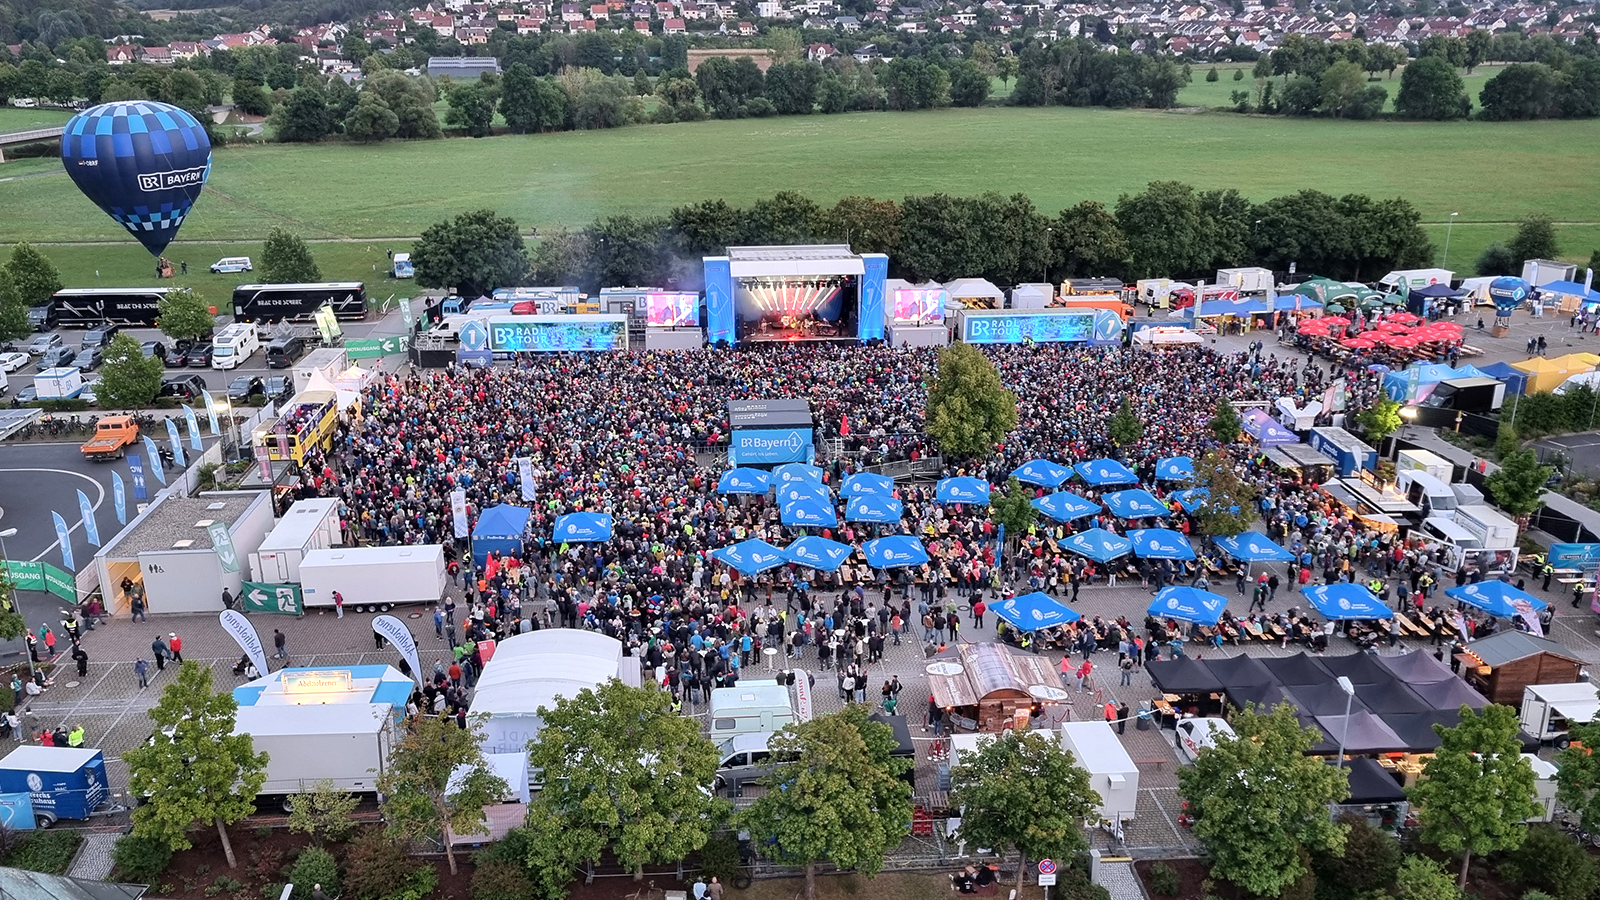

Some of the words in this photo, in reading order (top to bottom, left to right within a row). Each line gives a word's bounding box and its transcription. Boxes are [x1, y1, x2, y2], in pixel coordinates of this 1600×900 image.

[142, 176, 159, 189] BR
[167, 171, 201, 185] BAYERN
[710, 291, 718, 308] 1
[866, 288, 874, 305] 1
[542, 302, 555, 314] BR
[971, 320, 990, 336] BR
[991, 320, 1019, 328] RADL
[1105, 320, 1115, 334] 1
[468, 329, 477, 345] 1
[495, 327, 516, 345] BR
[516, 328, 548, 336] RADL
[517, 336, 549, 344] TOUR
[741, 437, 753, 448] BR
